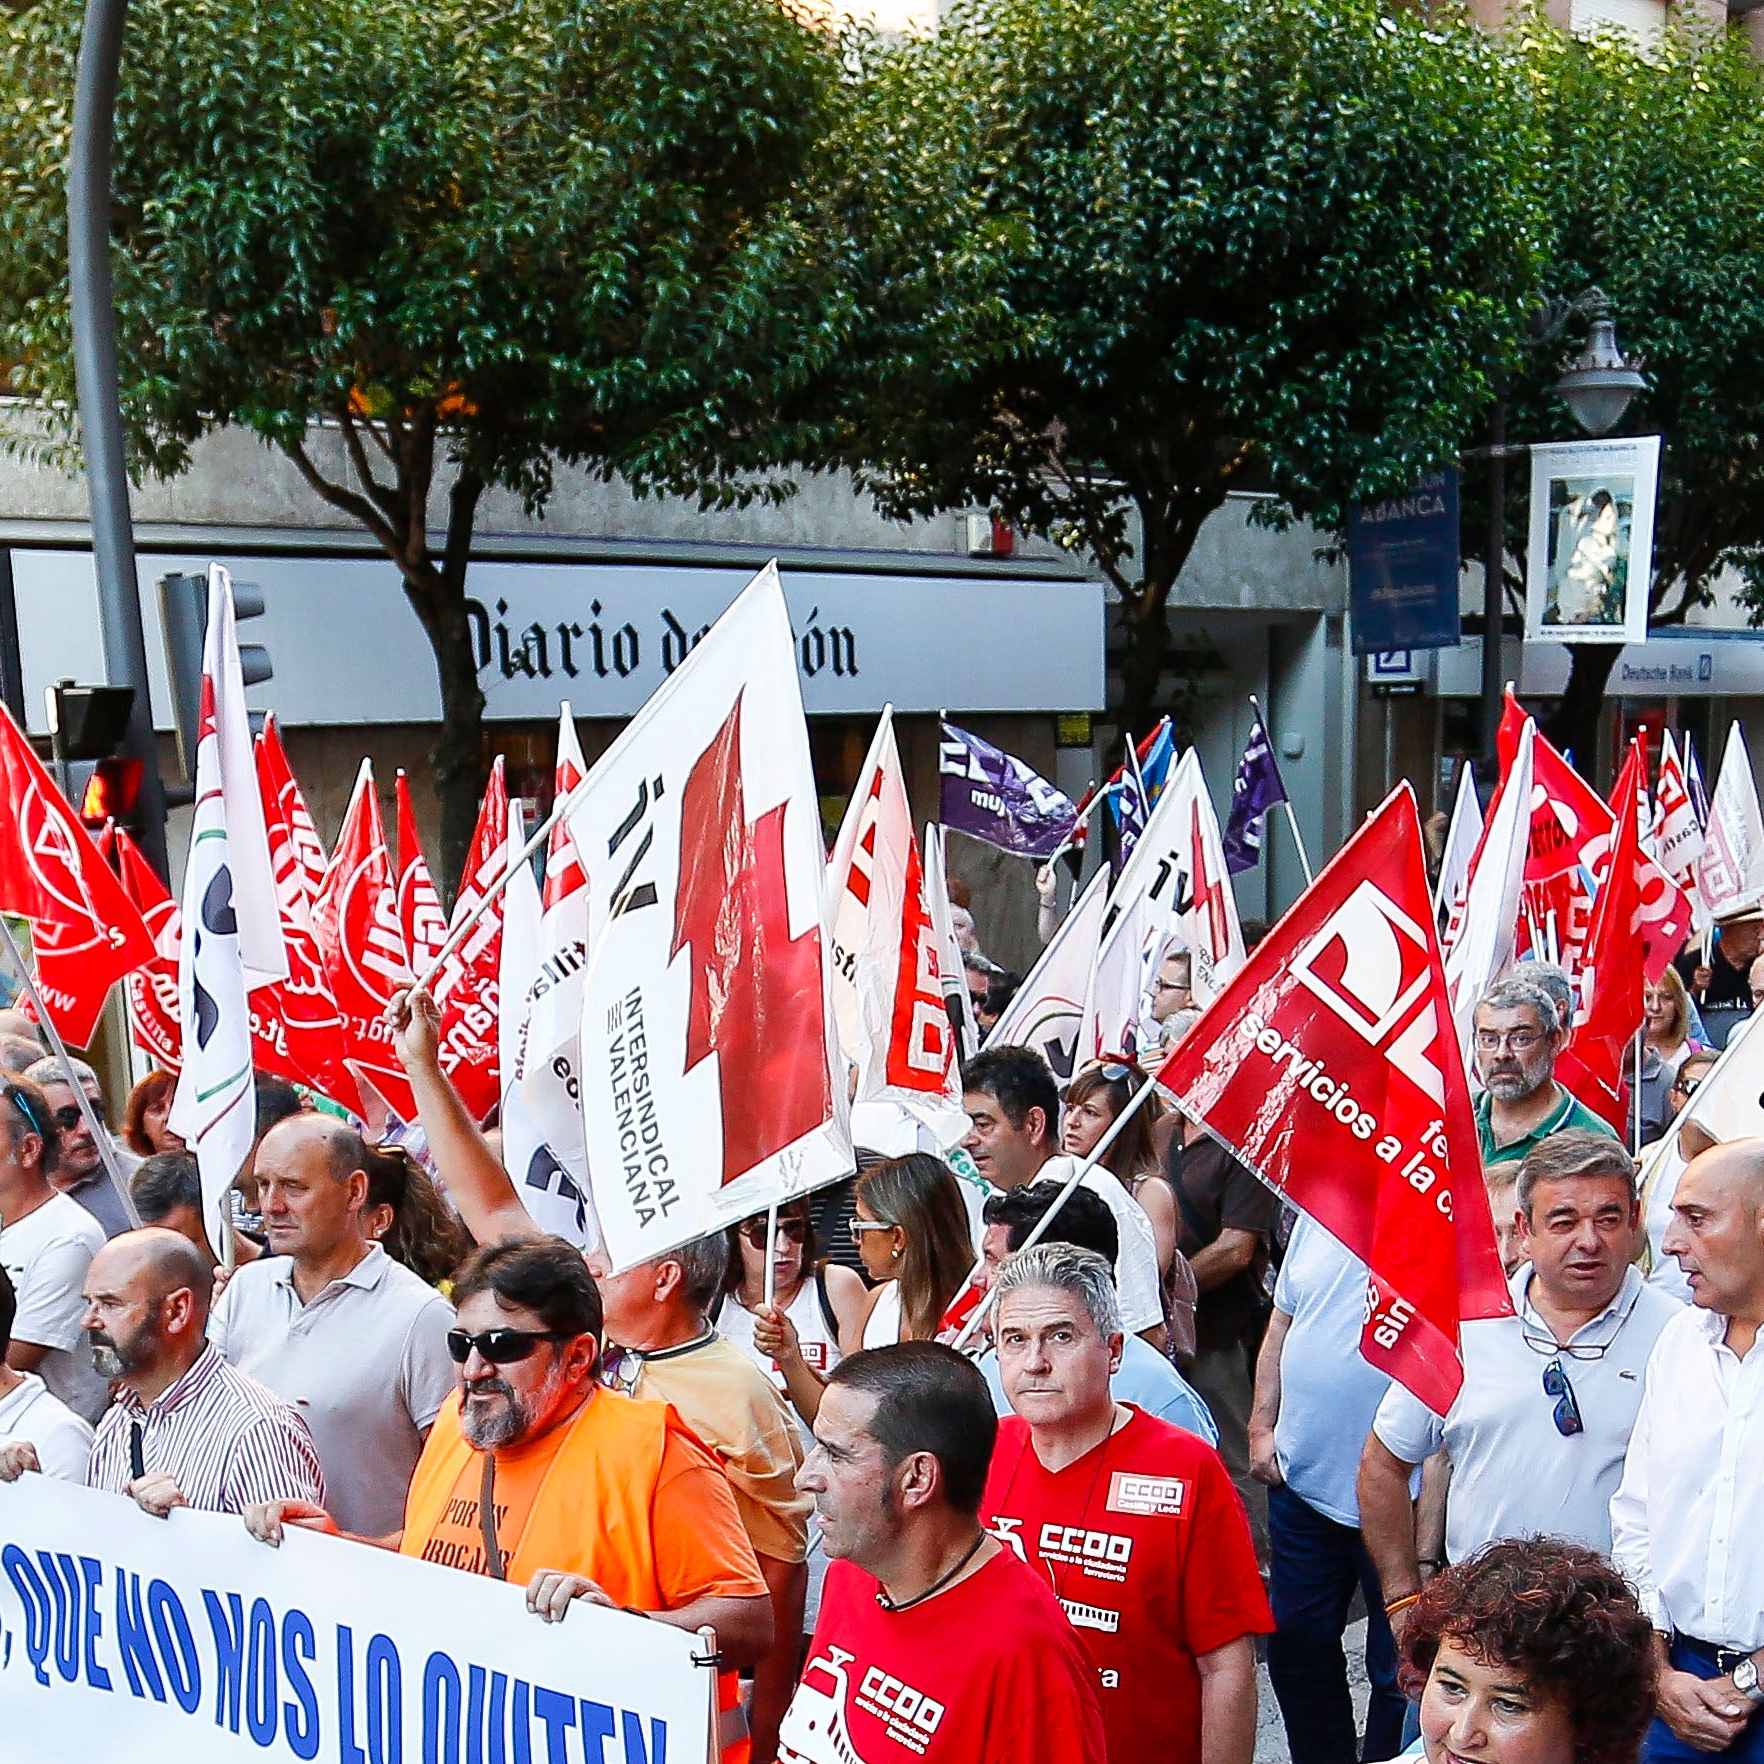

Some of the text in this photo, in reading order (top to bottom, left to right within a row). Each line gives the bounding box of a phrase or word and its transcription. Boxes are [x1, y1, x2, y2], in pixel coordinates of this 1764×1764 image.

[607, 1033, 657, 1230] VALENCIANA
[624, 985, 681, 1219] INTERSINDICAL
[1239, 1012, 1377, 1141] servicios
[1375, 1134, 1403, 1164] a
[1400, 1150, 1437, 1194] la
[1038, 1522, 1134, 1564] CCOO
[1, 1543, 114, 1692] QUE
[114, 1565, 203, 1715] NO
[201, 1588, 320, 1762] NOS
[859, 1664, 946, 1735] CCOO
